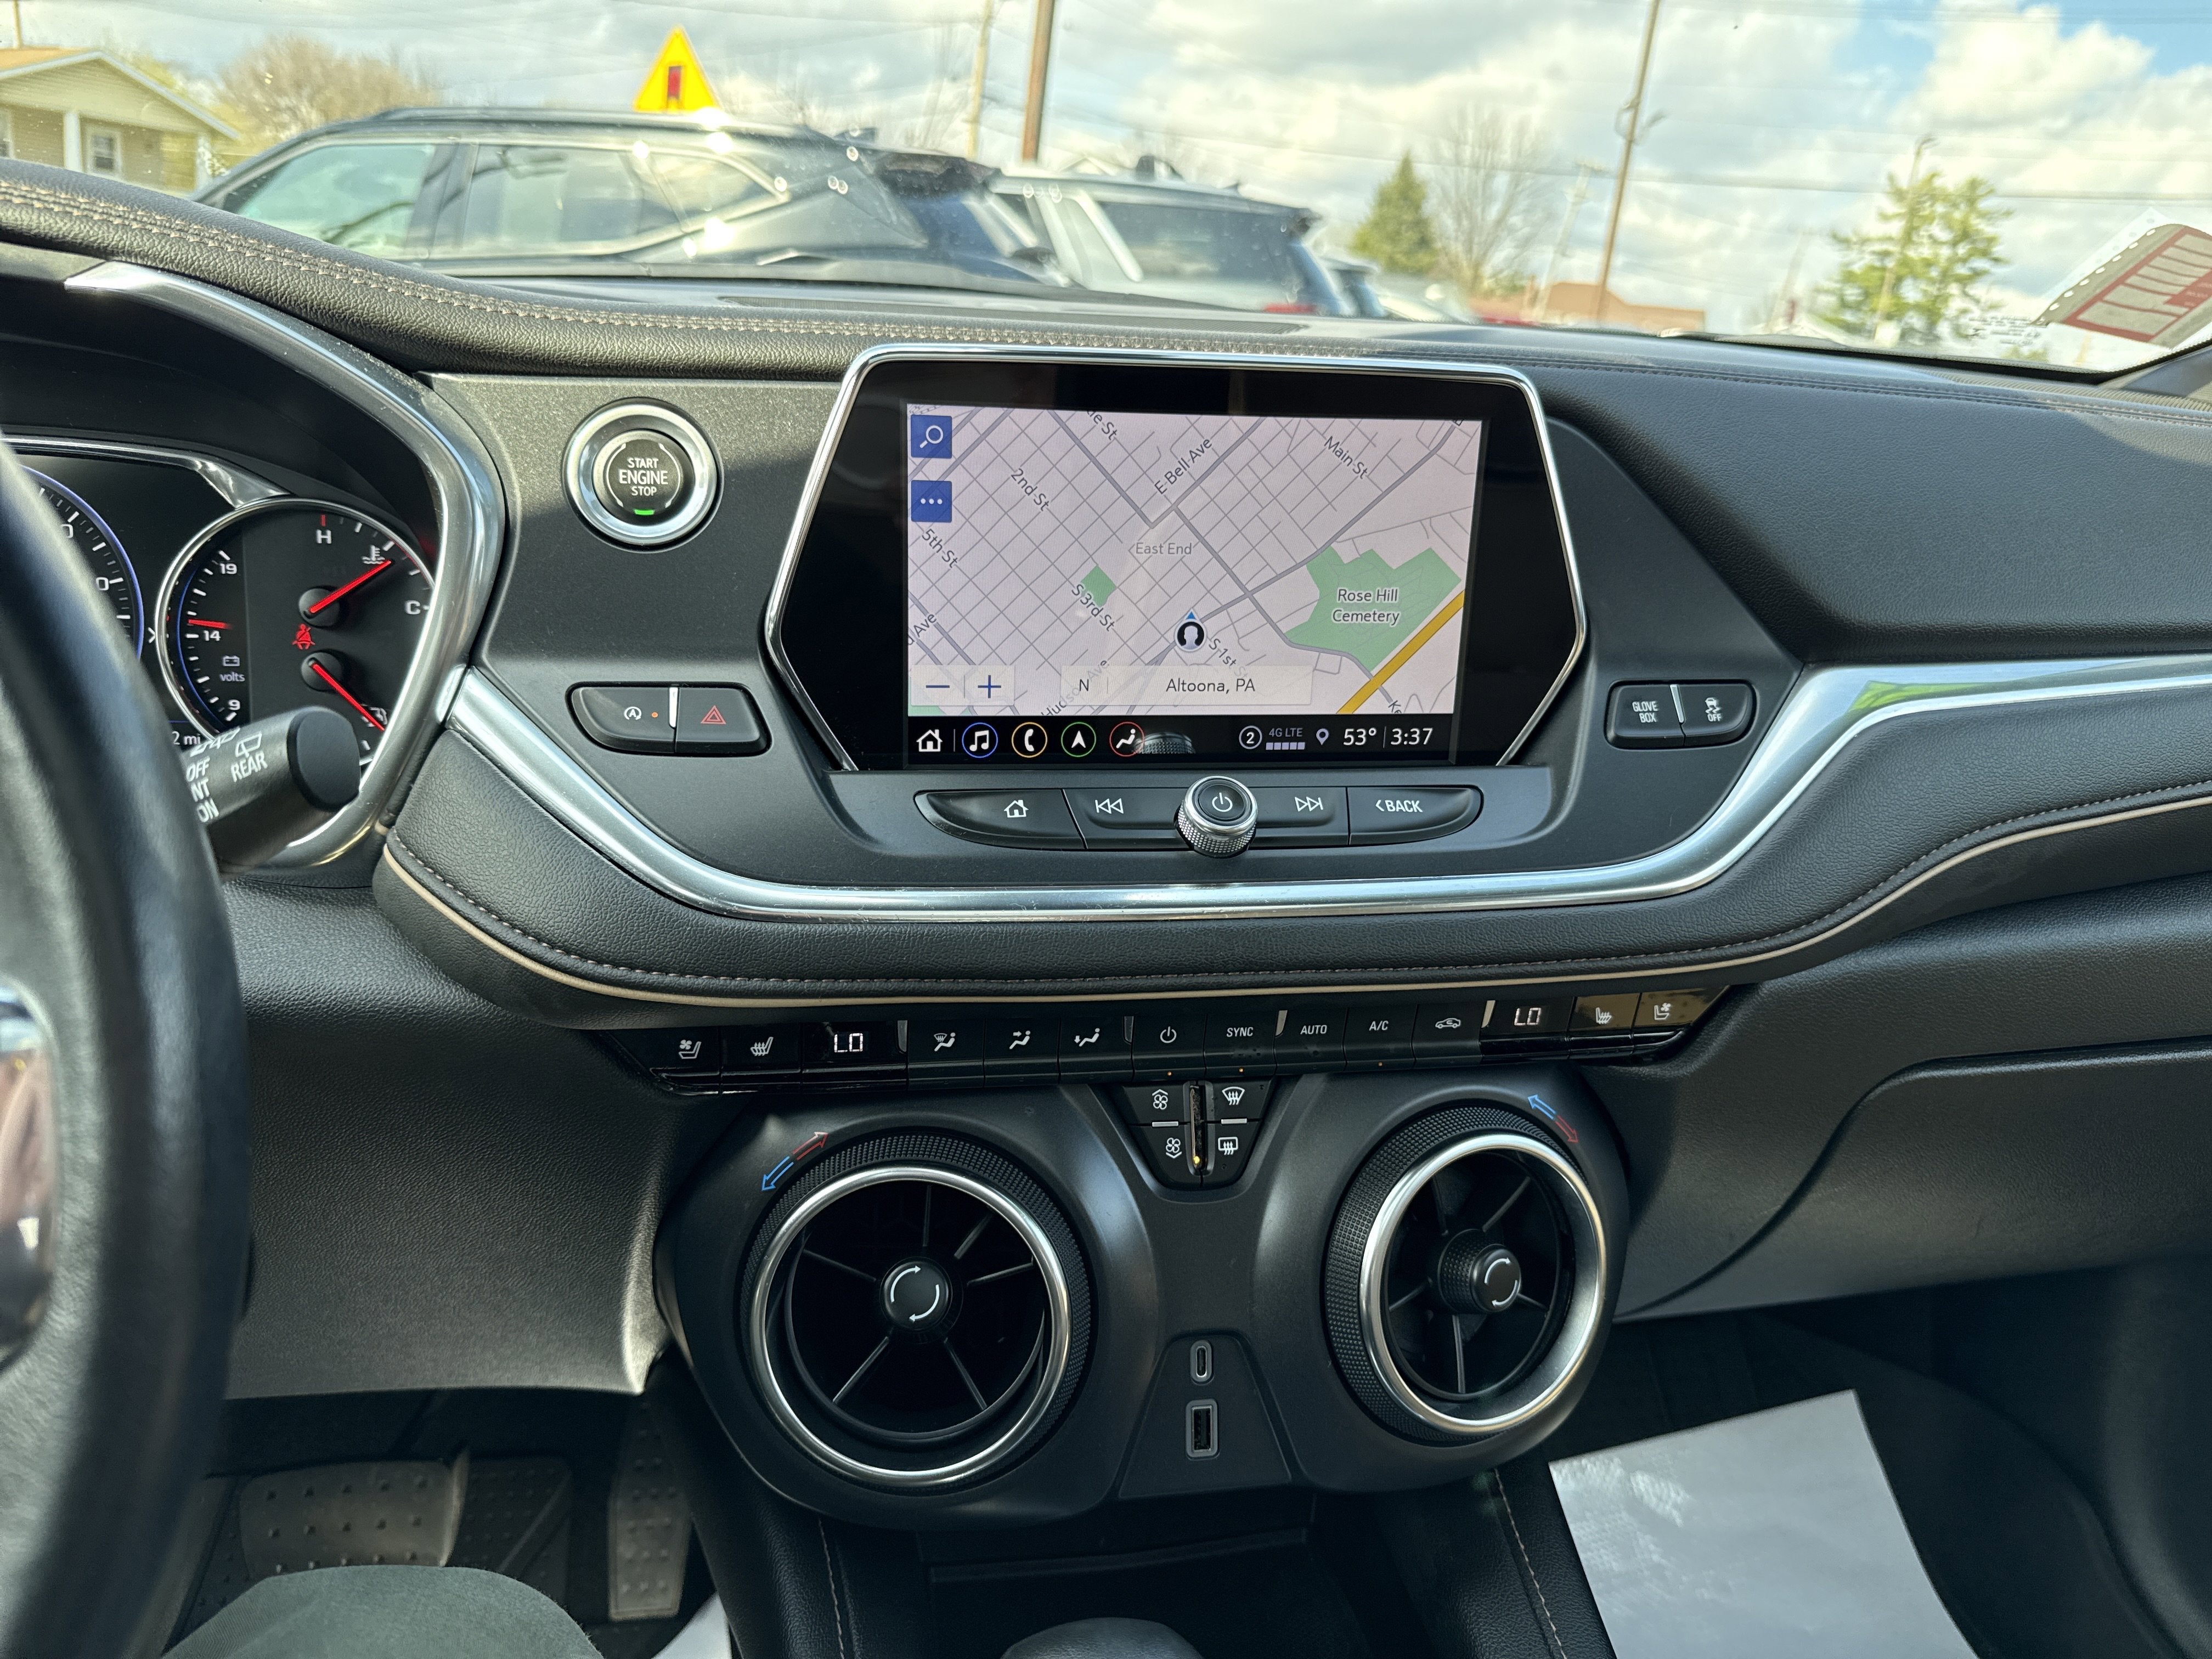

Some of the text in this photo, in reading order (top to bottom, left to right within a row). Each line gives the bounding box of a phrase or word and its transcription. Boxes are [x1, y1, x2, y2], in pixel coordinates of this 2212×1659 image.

[1102, 422, 1117, 441] St
[628, 458, 658, 469] START
[1324, 436, 1368, 479] Main St
[1154, 439, 1211, 494] E Bell Ave
[619, 470, 668, 484] ENGINE
[631, 486, 657, 496] STOP
[1011, 469, 1049, 512] 2nd St
[316, 529, 332, 544] H
[922, 529, 958, 568] 5th St
[1136, 543, 1192, 555] East End
[220, 563, 237, 574] 19
[1338, 589, 1398, 602] Rose Hill
[404, 600, 421, 614] C
[1071, 584, 1115, 631] S 3rd St
[1333, 610, 1400, 625] Cemetery
[913, 614, 936, 637] Ave
[204, 630, 221, 641] 14
[1209, 639, 1221, 650] S
[1219, 648, 1236, 669] 1st
[219, 672, 245, 682] volts
[1080, 679, 1088, 691] N
[1166, 678, 1255, 694] Altoona, PA
[228, 699, 240, 710] 9
[1632, 701, 1658, 712] GLOVE
[1639, 713, 1656, 723] BOX
[1707, 714, 1722, 722] OFF
[184, 733, 201, 745] mi
[1246, 728, 1433, 746] 2 4G LTE 53° 3:37
[186, 755, 211, 782] OFF
[230, 750, 268, 782] REAR
[190, 777, 210, 802] NT
[196, 798, 219, 822] ON
[1385, 800, 1422, 813] BACK
[1226, 1026, 1254, 1037] SYNC
[1300, 1024, 1328, 1035] AUTO
[1369, 1020, 1389, 1031] A/C
